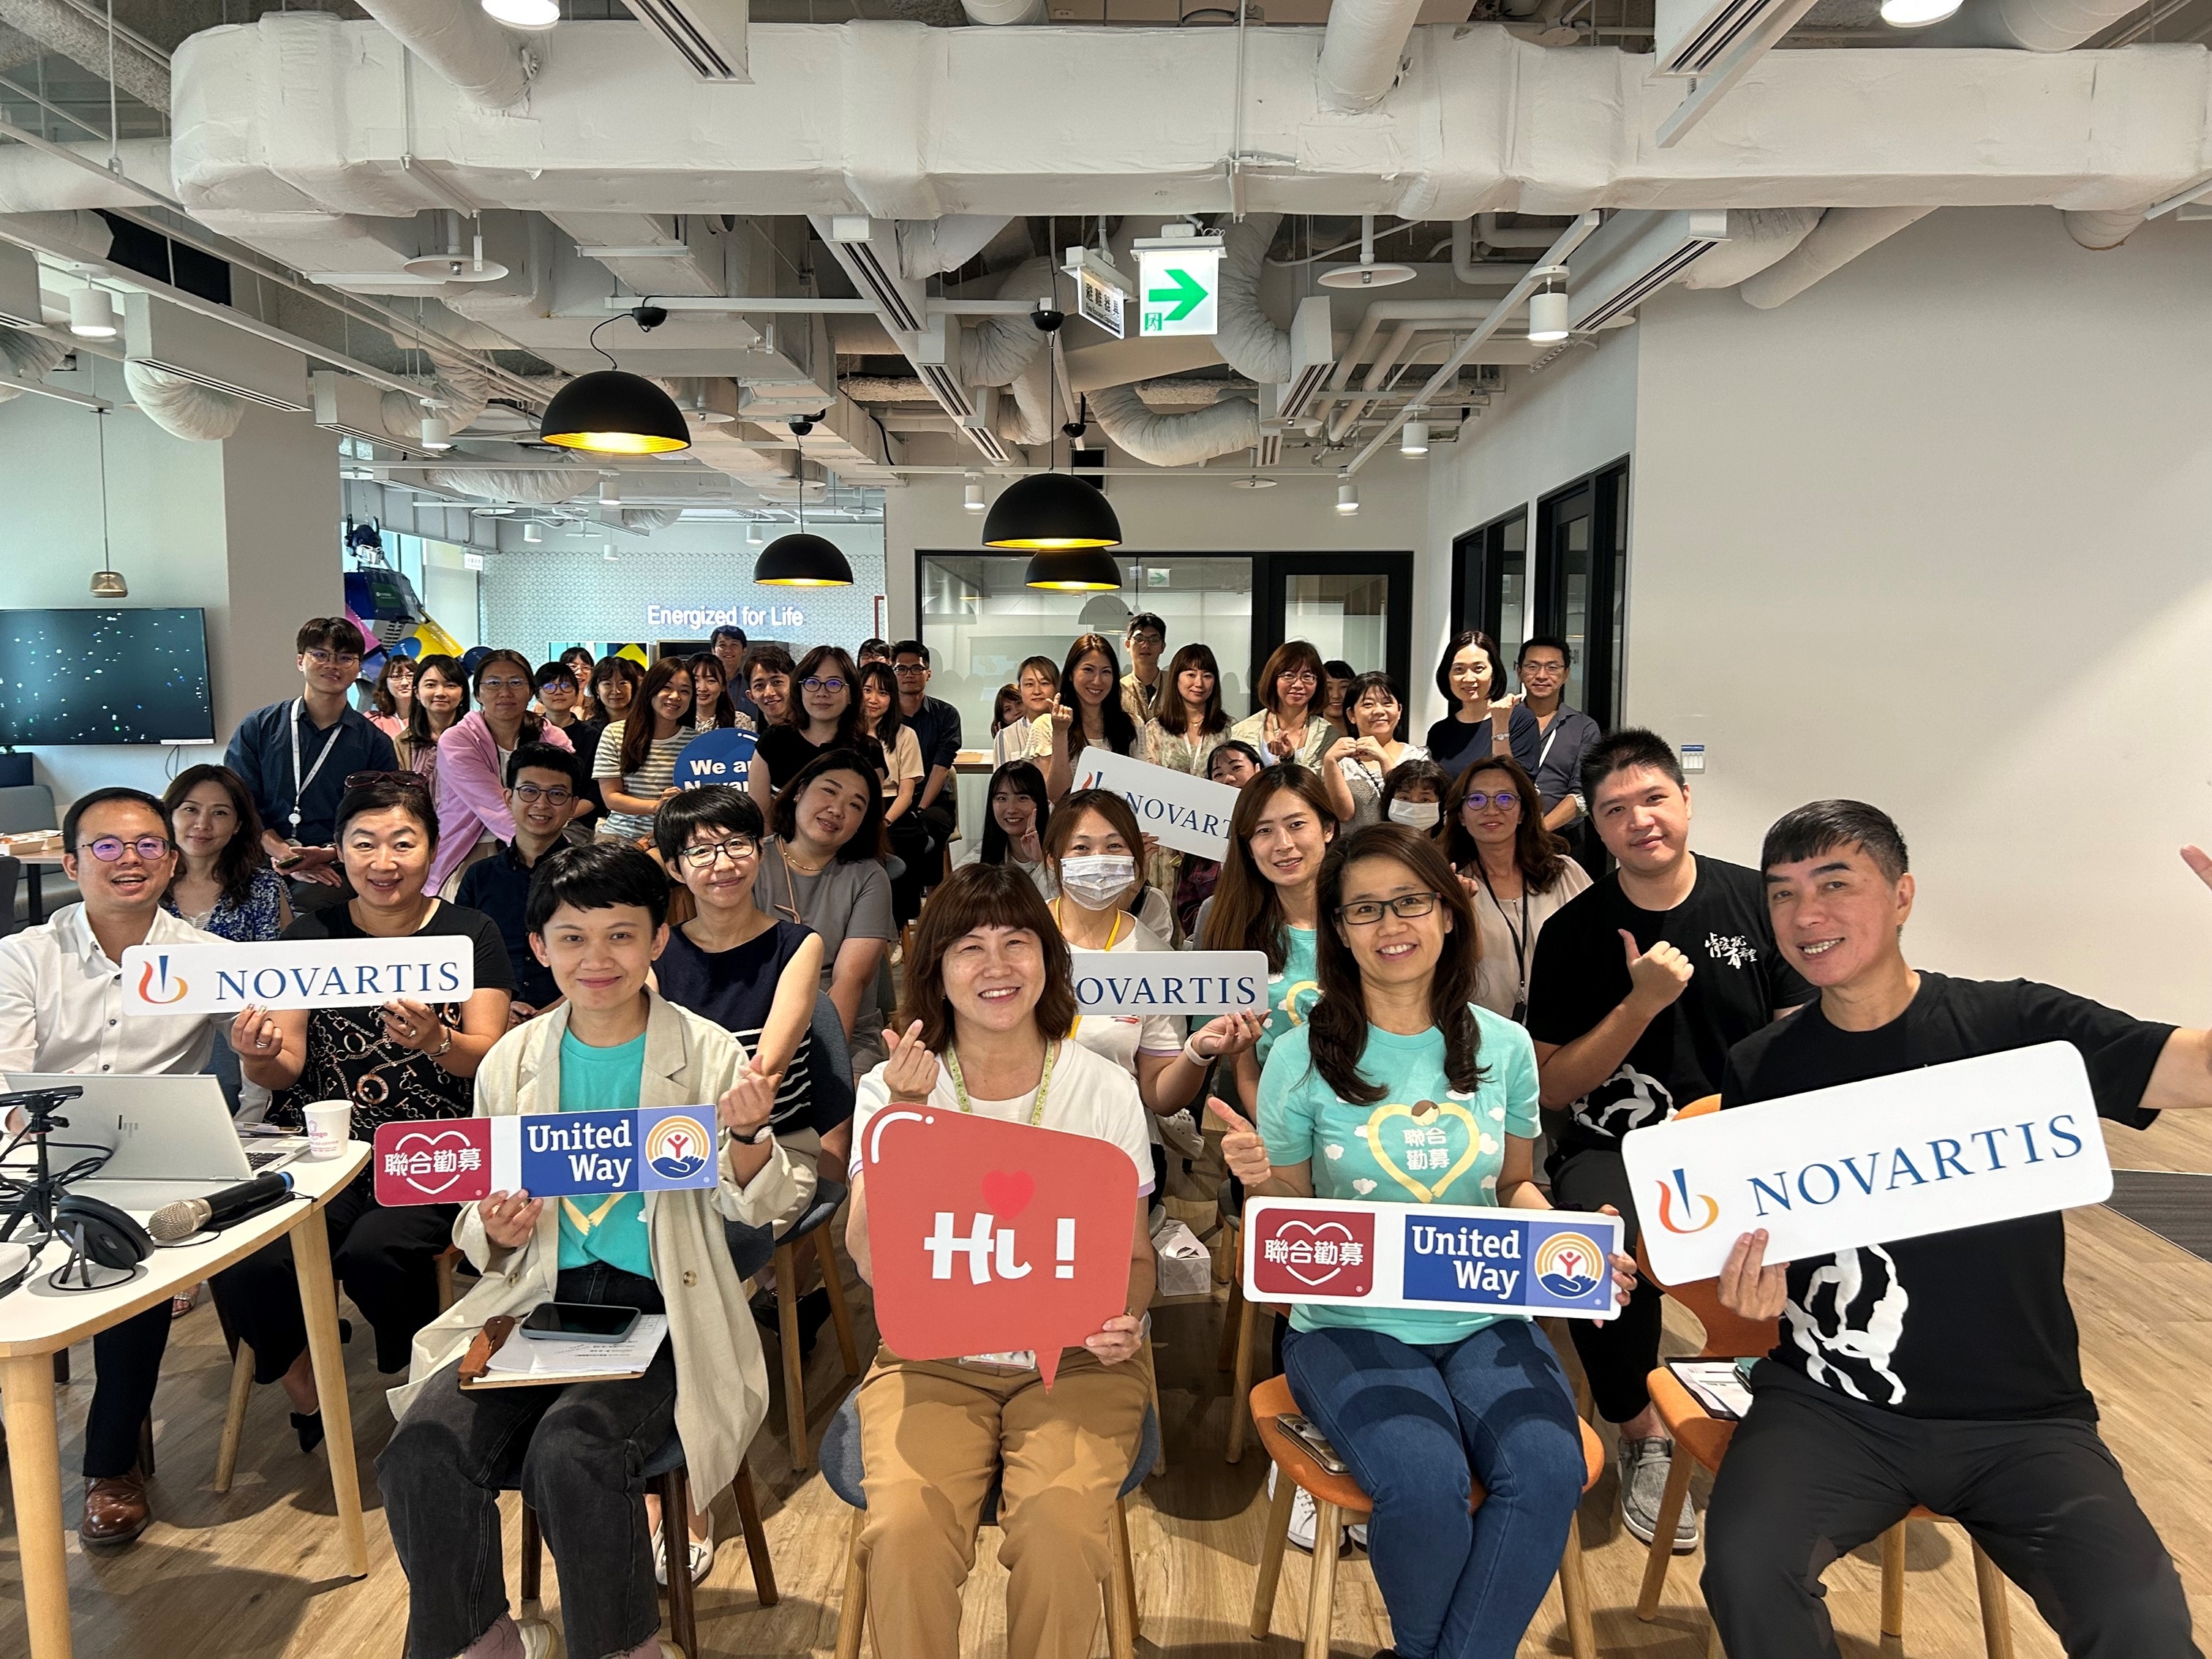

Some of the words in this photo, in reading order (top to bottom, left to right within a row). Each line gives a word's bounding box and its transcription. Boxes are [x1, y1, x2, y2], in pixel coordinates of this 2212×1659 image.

[647, 605, 737, 629] Energized
[742, 606, 767, 625] for
[770, 606, 804, 625] Life
[690, 759, 726, 776] We
[1126, 791, 1232, 840] NOVART
[216, 962, 459, 1000] NOVARTIS
[1076, 977, 1256, 1005] OVARTIS
[527, 1119, 632, 1153] United
[1402, 1127, 1448, 1147] 聯合
[384, 1148, 482, 1177] 聯合勸募
[568, 1153, 631, 1187] Way
[1405, 1148, 1451, 1170] 勸募
[1746, 1115, 2083, 1217] NOVARTIS
[1264, 1238, 1364, 1266] 聯合勸募
[1412, 1225, 1522, 1260] United
[1453, 1260, 1521, 1299] Way
